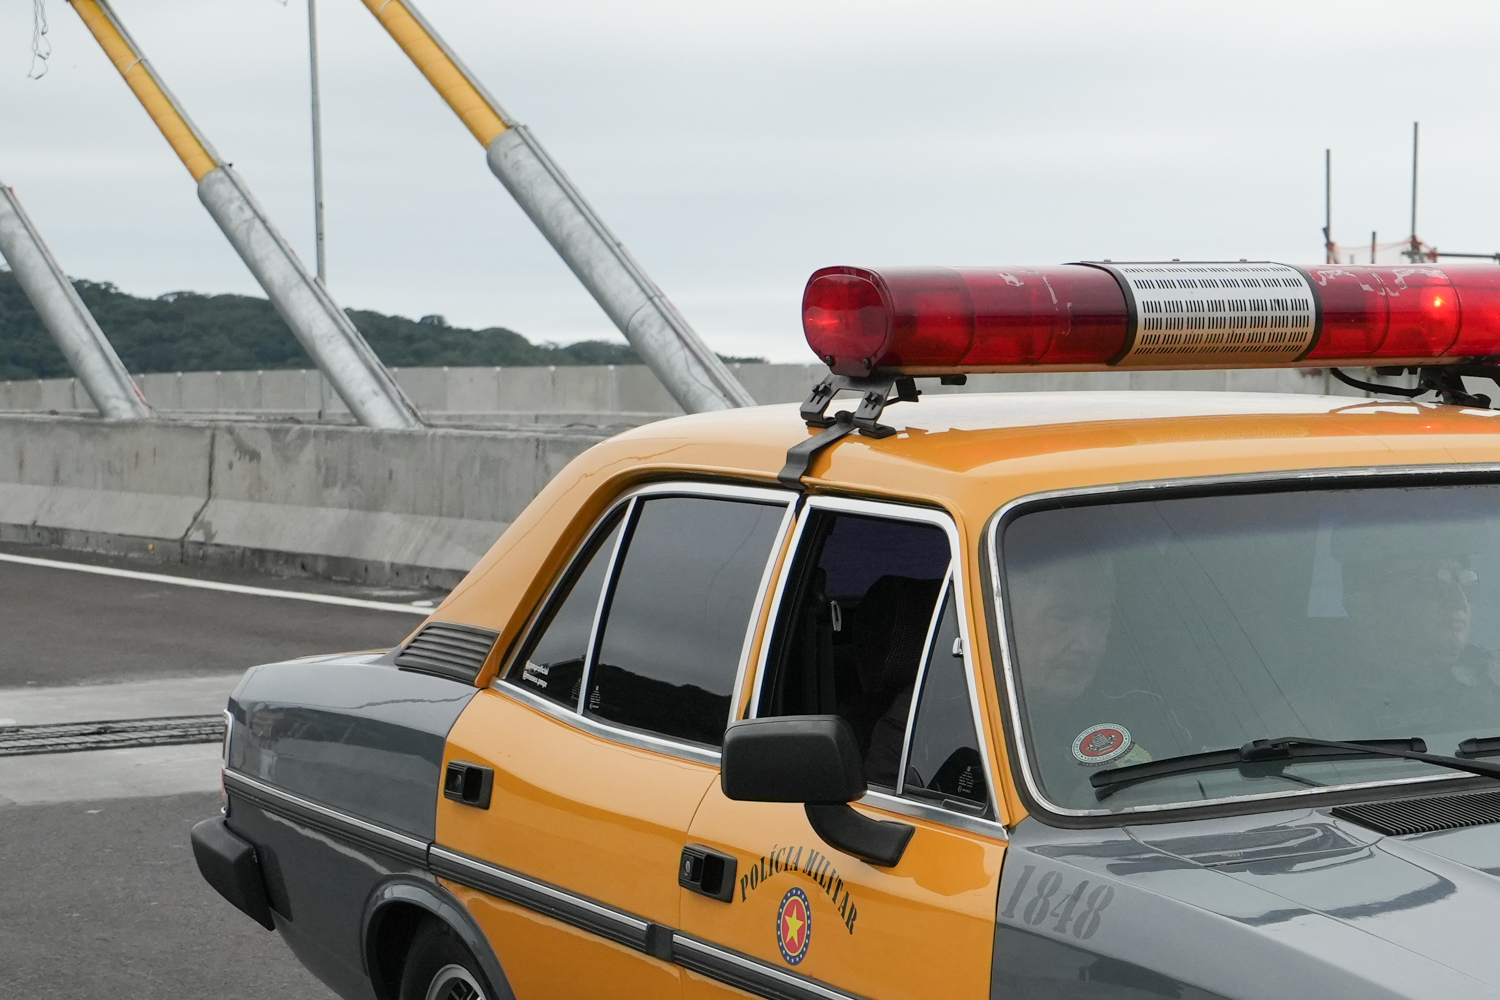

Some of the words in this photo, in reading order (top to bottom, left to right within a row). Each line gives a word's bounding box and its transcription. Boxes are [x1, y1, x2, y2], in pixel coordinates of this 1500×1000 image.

[740, 844, 803, 903] POLÍCIA
[802, 846, 858, 935] MILITAR
[1001, 864, 1116, 940] 1848
